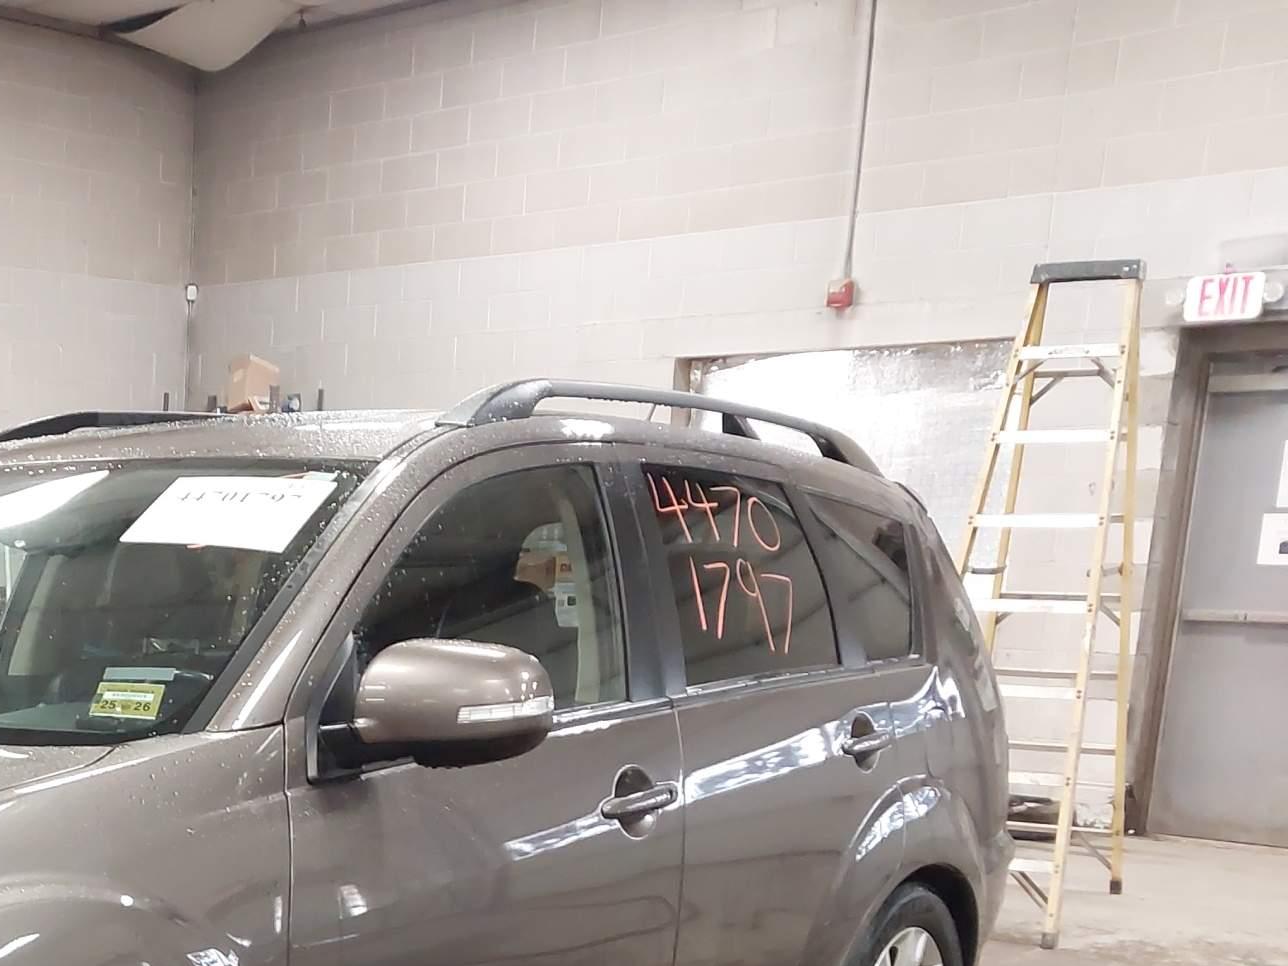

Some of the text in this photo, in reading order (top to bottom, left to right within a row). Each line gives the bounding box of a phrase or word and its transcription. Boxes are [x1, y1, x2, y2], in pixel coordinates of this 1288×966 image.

[1198, 275, 1254, 317] EXIT
[647, 473, 781, 551] 4470
[688, 556, 793, 655] 1797
[99, 700, 152, 712] 25 26
